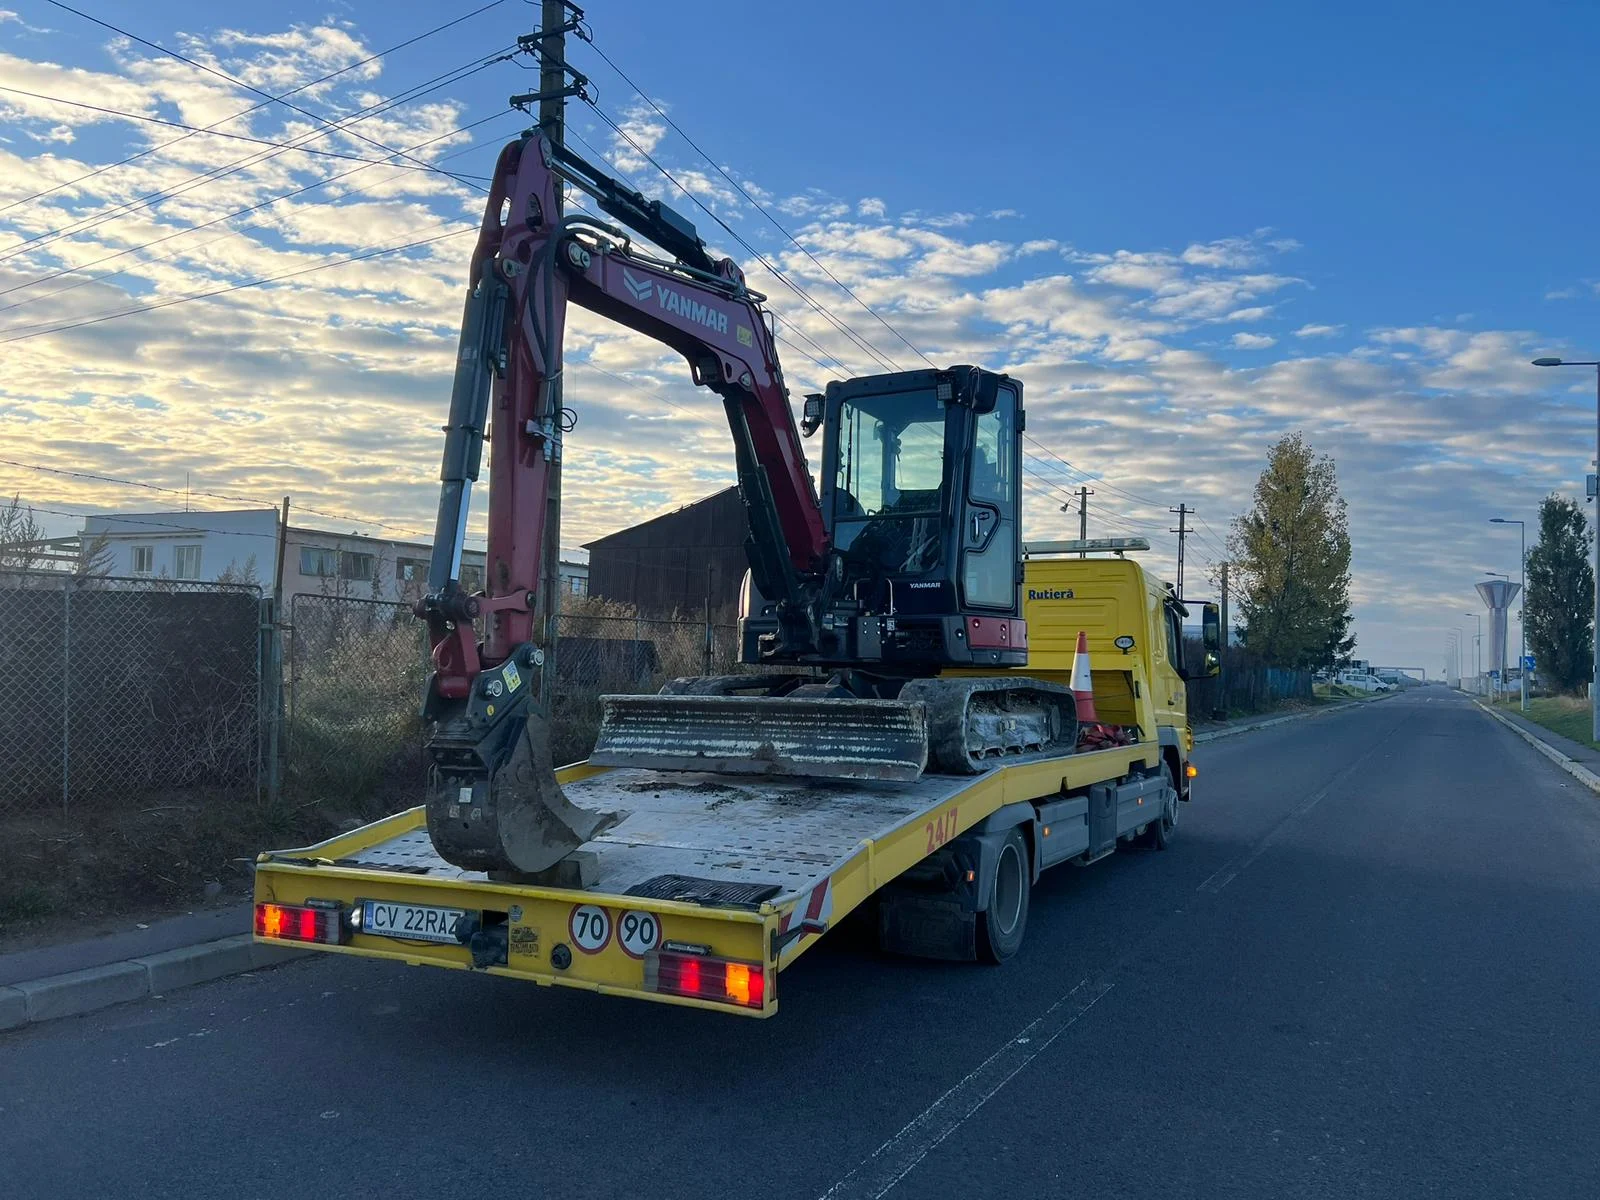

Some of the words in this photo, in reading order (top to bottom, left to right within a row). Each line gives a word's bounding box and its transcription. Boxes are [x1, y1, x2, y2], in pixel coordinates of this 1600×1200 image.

[656, 284, 728, 334] YANMAR
[1028, 588, 1074, 600] Rutieră
[926, 807, 957, 854] 24/7
[375, 905, 399, 928] CV
[577, 912, 604, 940] 70
[624, 914, 654, 945] 90
